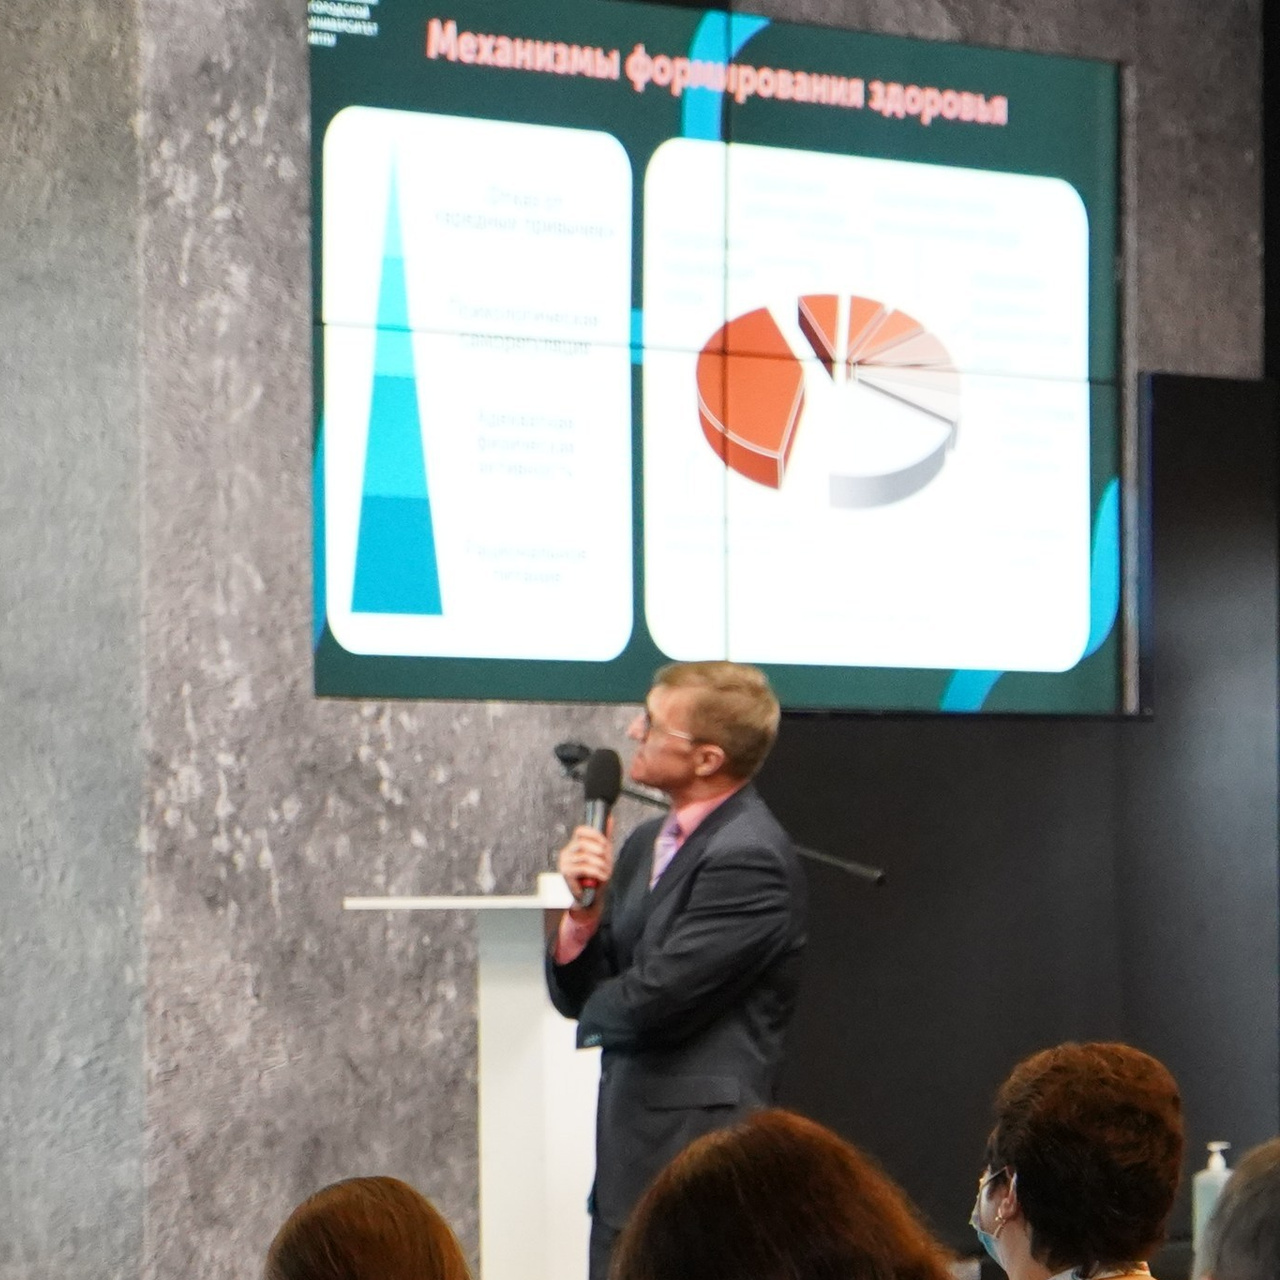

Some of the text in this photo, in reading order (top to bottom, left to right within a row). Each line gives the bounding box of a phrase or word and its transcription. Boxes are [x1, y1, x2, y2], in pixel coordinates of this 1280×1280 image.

[426, 17, 1008, 126] Механизмы формирования здоровья
